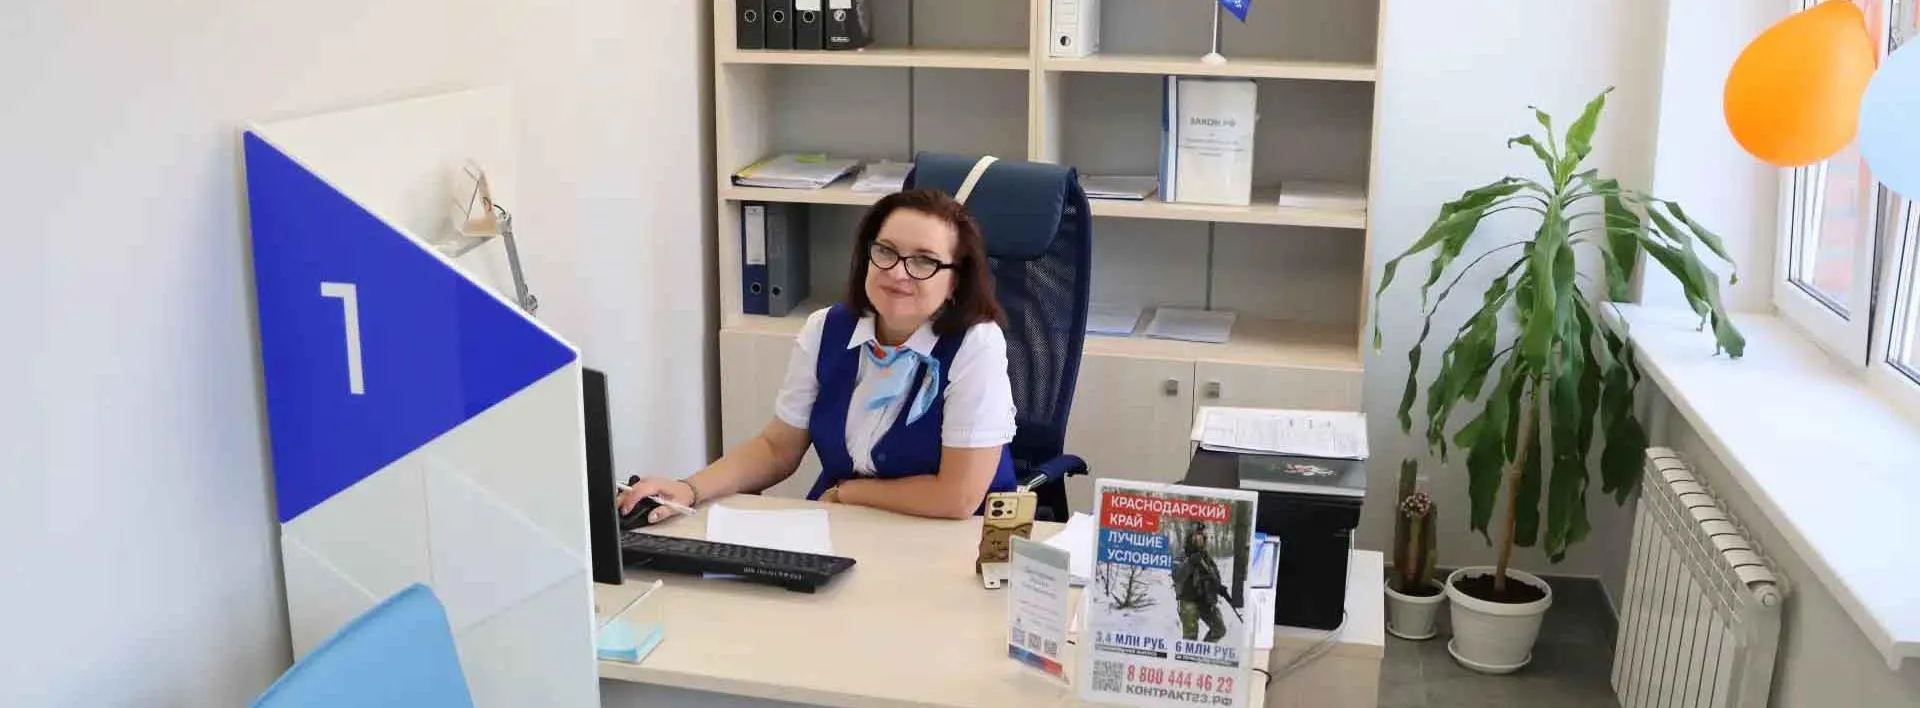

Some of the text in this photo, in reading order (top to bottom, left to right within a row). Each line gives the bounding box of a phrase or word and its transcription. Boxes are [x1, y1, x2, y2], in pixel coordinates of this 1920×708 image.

[320, 281, 365, 395] 1
[1111, 495, 1226, 519] КРАСНОДАРСКИЙ
[1109, 512, 1143, 528] КРАЙ
[1107, 531, 1163, 549] ЛУЧШИЕ
[1106, 549, 1172, 567] УСЛОВИЯ!
[1115, 633, 1140, 647] МЛН
[1143, 637, 1168, 651] РУБ.
[1175, 640, 1182, 652] 6
[1185, 641, 1210, 656] МЛН
[1213, 645, 1239, 660] РУБ.
[1127, 664, 1234, 694] 8 800 444 46 23
[1126, 684, 1233, 706] КОНТРАКТ23.РФ
